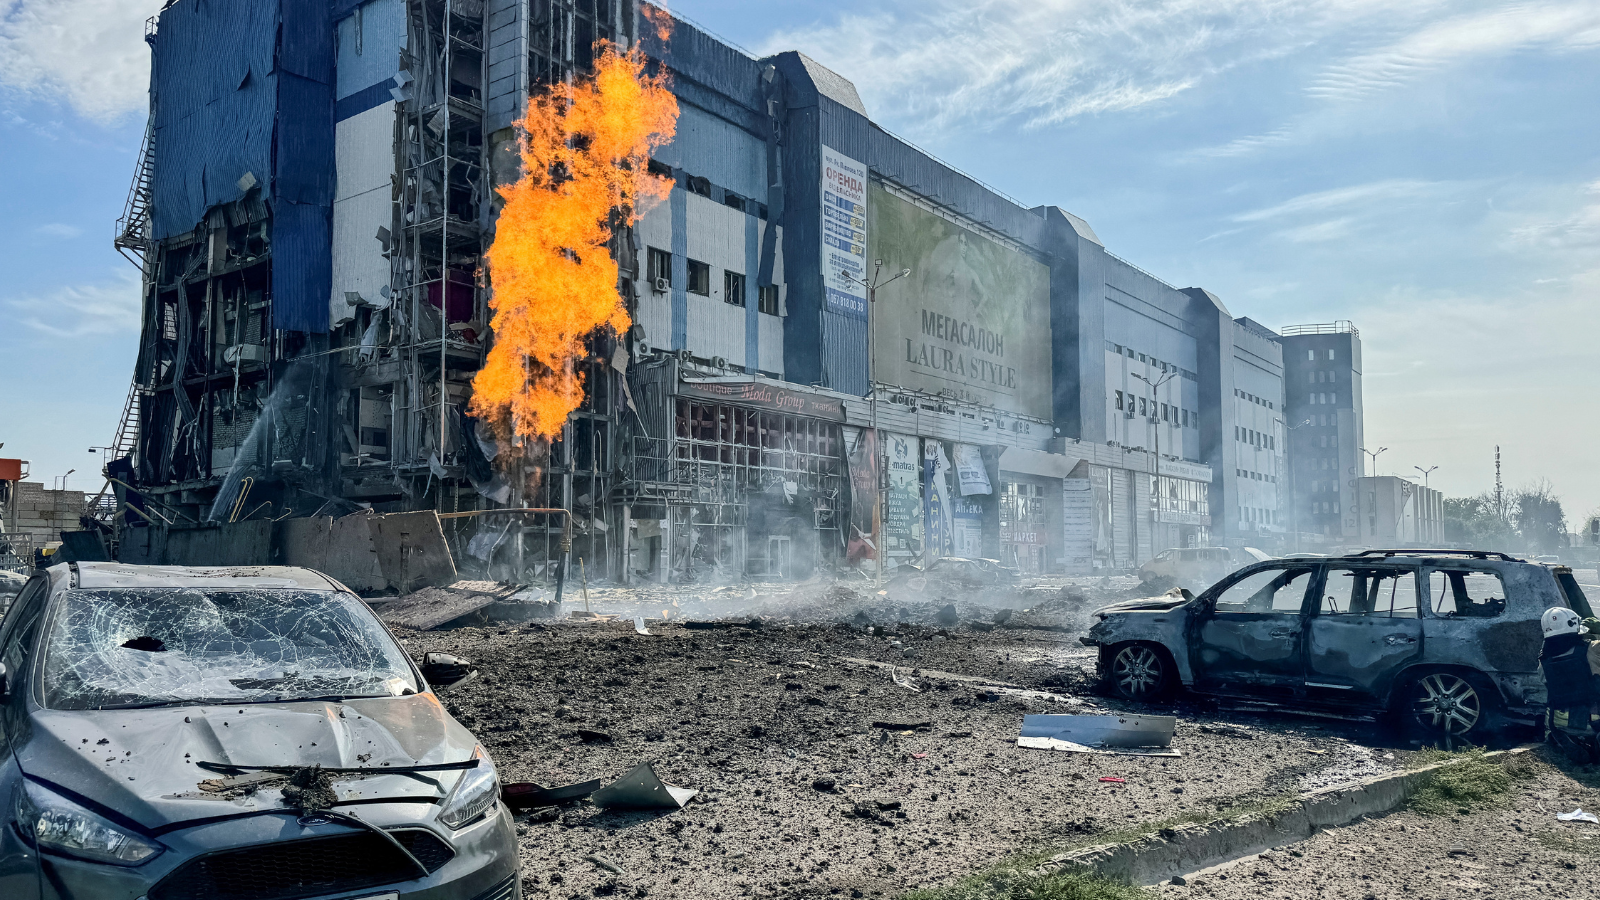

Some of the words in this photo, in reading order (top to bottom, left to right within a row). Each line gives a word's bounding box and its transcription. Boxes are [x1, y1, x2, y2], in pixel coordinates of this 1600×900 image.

[826, 166, 864, 194] ОРЕНДА
[850, 300, 856, 310] 00
[922, 310, 1003, 356] МЕГАСАЛОН
[905, 338, 966, 376] LAURA
[970, 356, 1016, 390] STYLE
[740, 384, 773, 402] Moda
[776, 390, 805, 413] Group
[942, 387, 958, 399] ВЕСЬ
[955, 504, 984, 515] АПЕКА
[1344, 518, 1355, 528] 12
